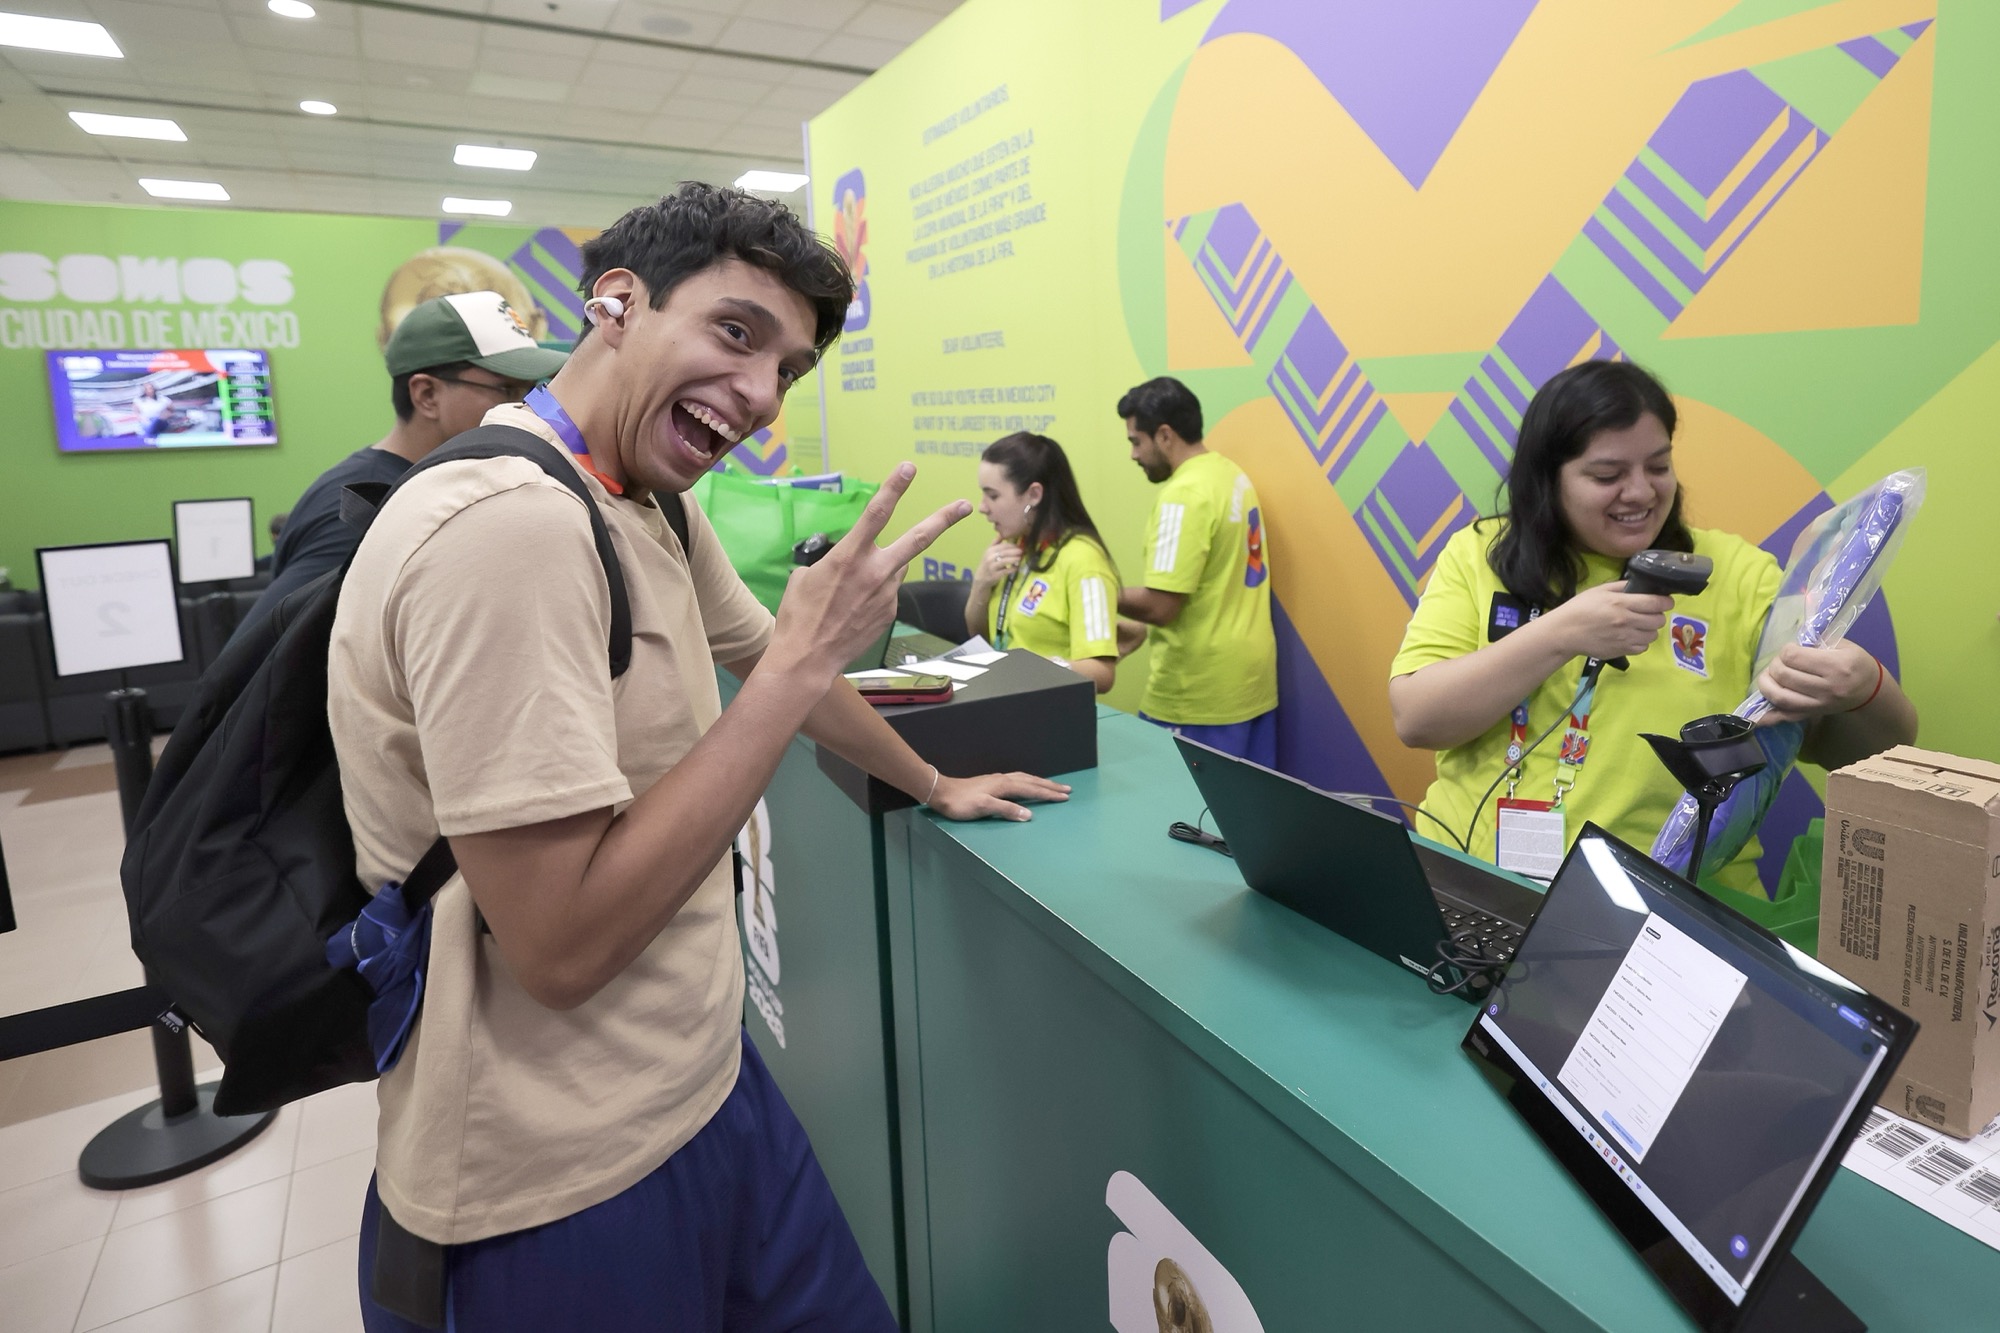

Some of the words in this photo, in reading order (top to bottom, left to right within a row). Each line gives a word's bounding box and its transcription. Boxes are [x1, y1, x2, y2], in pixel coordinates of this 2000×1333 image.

[1019, 155, 1030, 176] DE
[1, 308, 125, 349] CIUDAD
[131, 310, 175, 349] DE
[181, 302, 299, 349] MÉXICO
[1840, 819, 1850, 855] Unilever
[1908, 905, 1916, 924] PUEDE
[1957, 923, 1968, 958] UNILEVER
[1905, 953, 1913, 969] STICK
[1943, 948, 1951, 959] DE
[1904, 969, 1912, 978] DE
[1986, 925, 2000, 1009] Rexona
[1941, 973, 1949, 983] DE
[1905, 1085, 1914, 1114] Unilever
